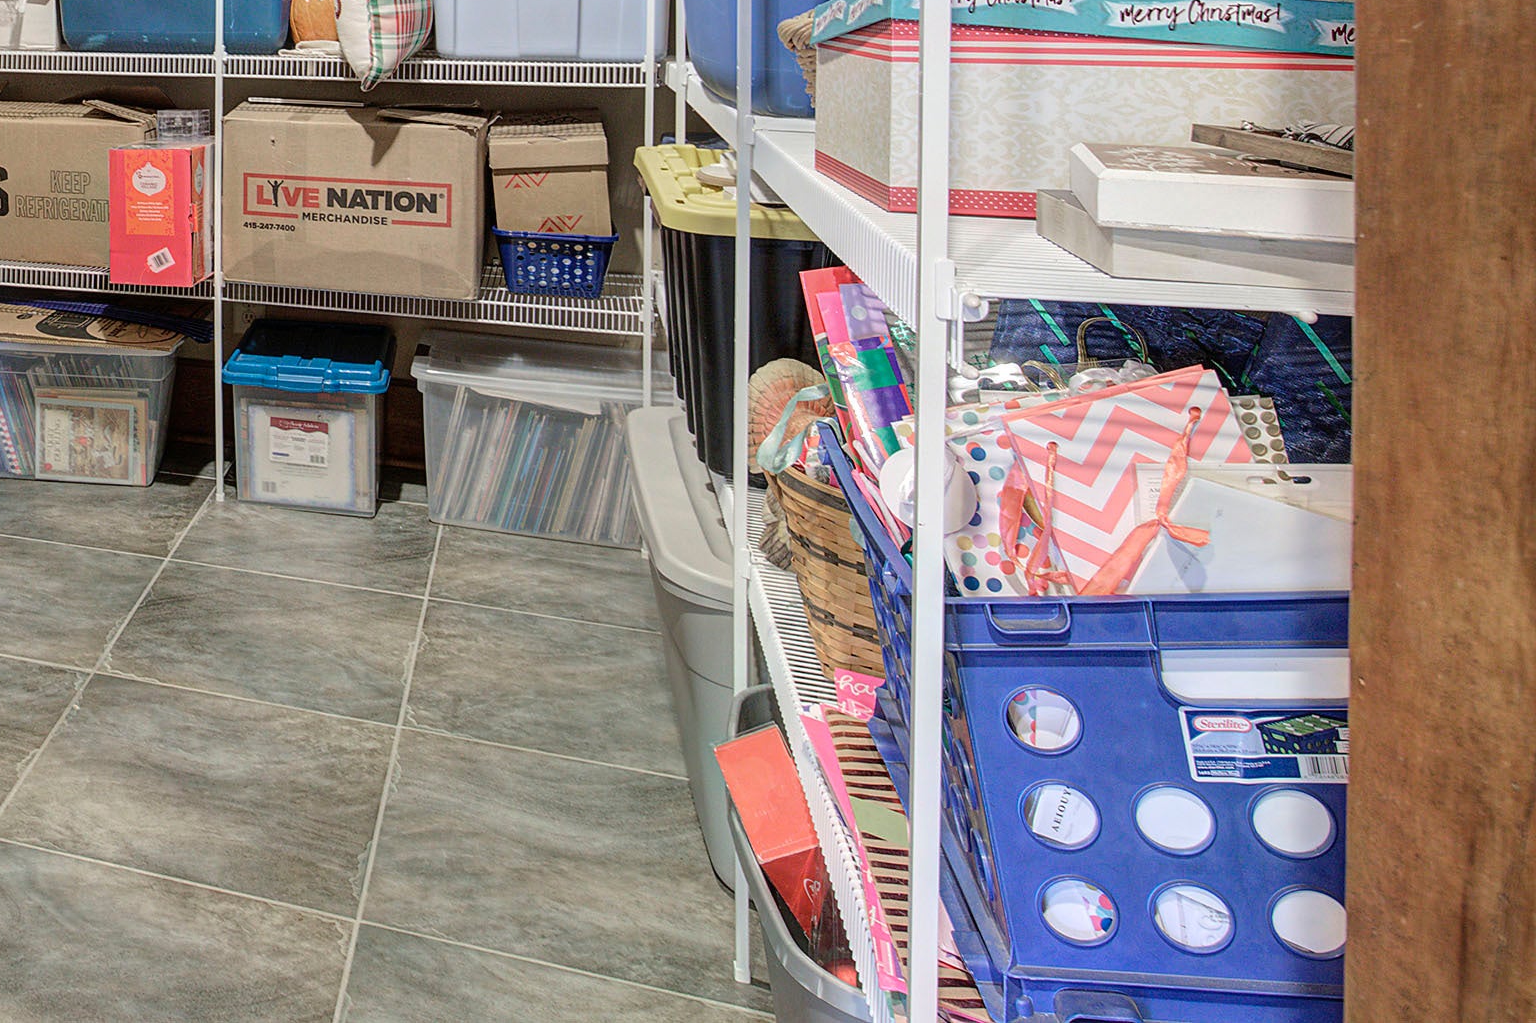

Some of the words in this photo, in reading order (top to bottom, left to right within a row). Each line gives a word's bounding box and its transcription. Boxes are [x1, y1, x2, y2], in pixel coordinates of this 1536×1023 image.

[50, 170, 91, 195] KEEP
[302, 212, 388, 226] MERCHANDISE
[243, 222, 296, 232] 415-247-7400
[1199, 719, 1242, 730] Sterilite
